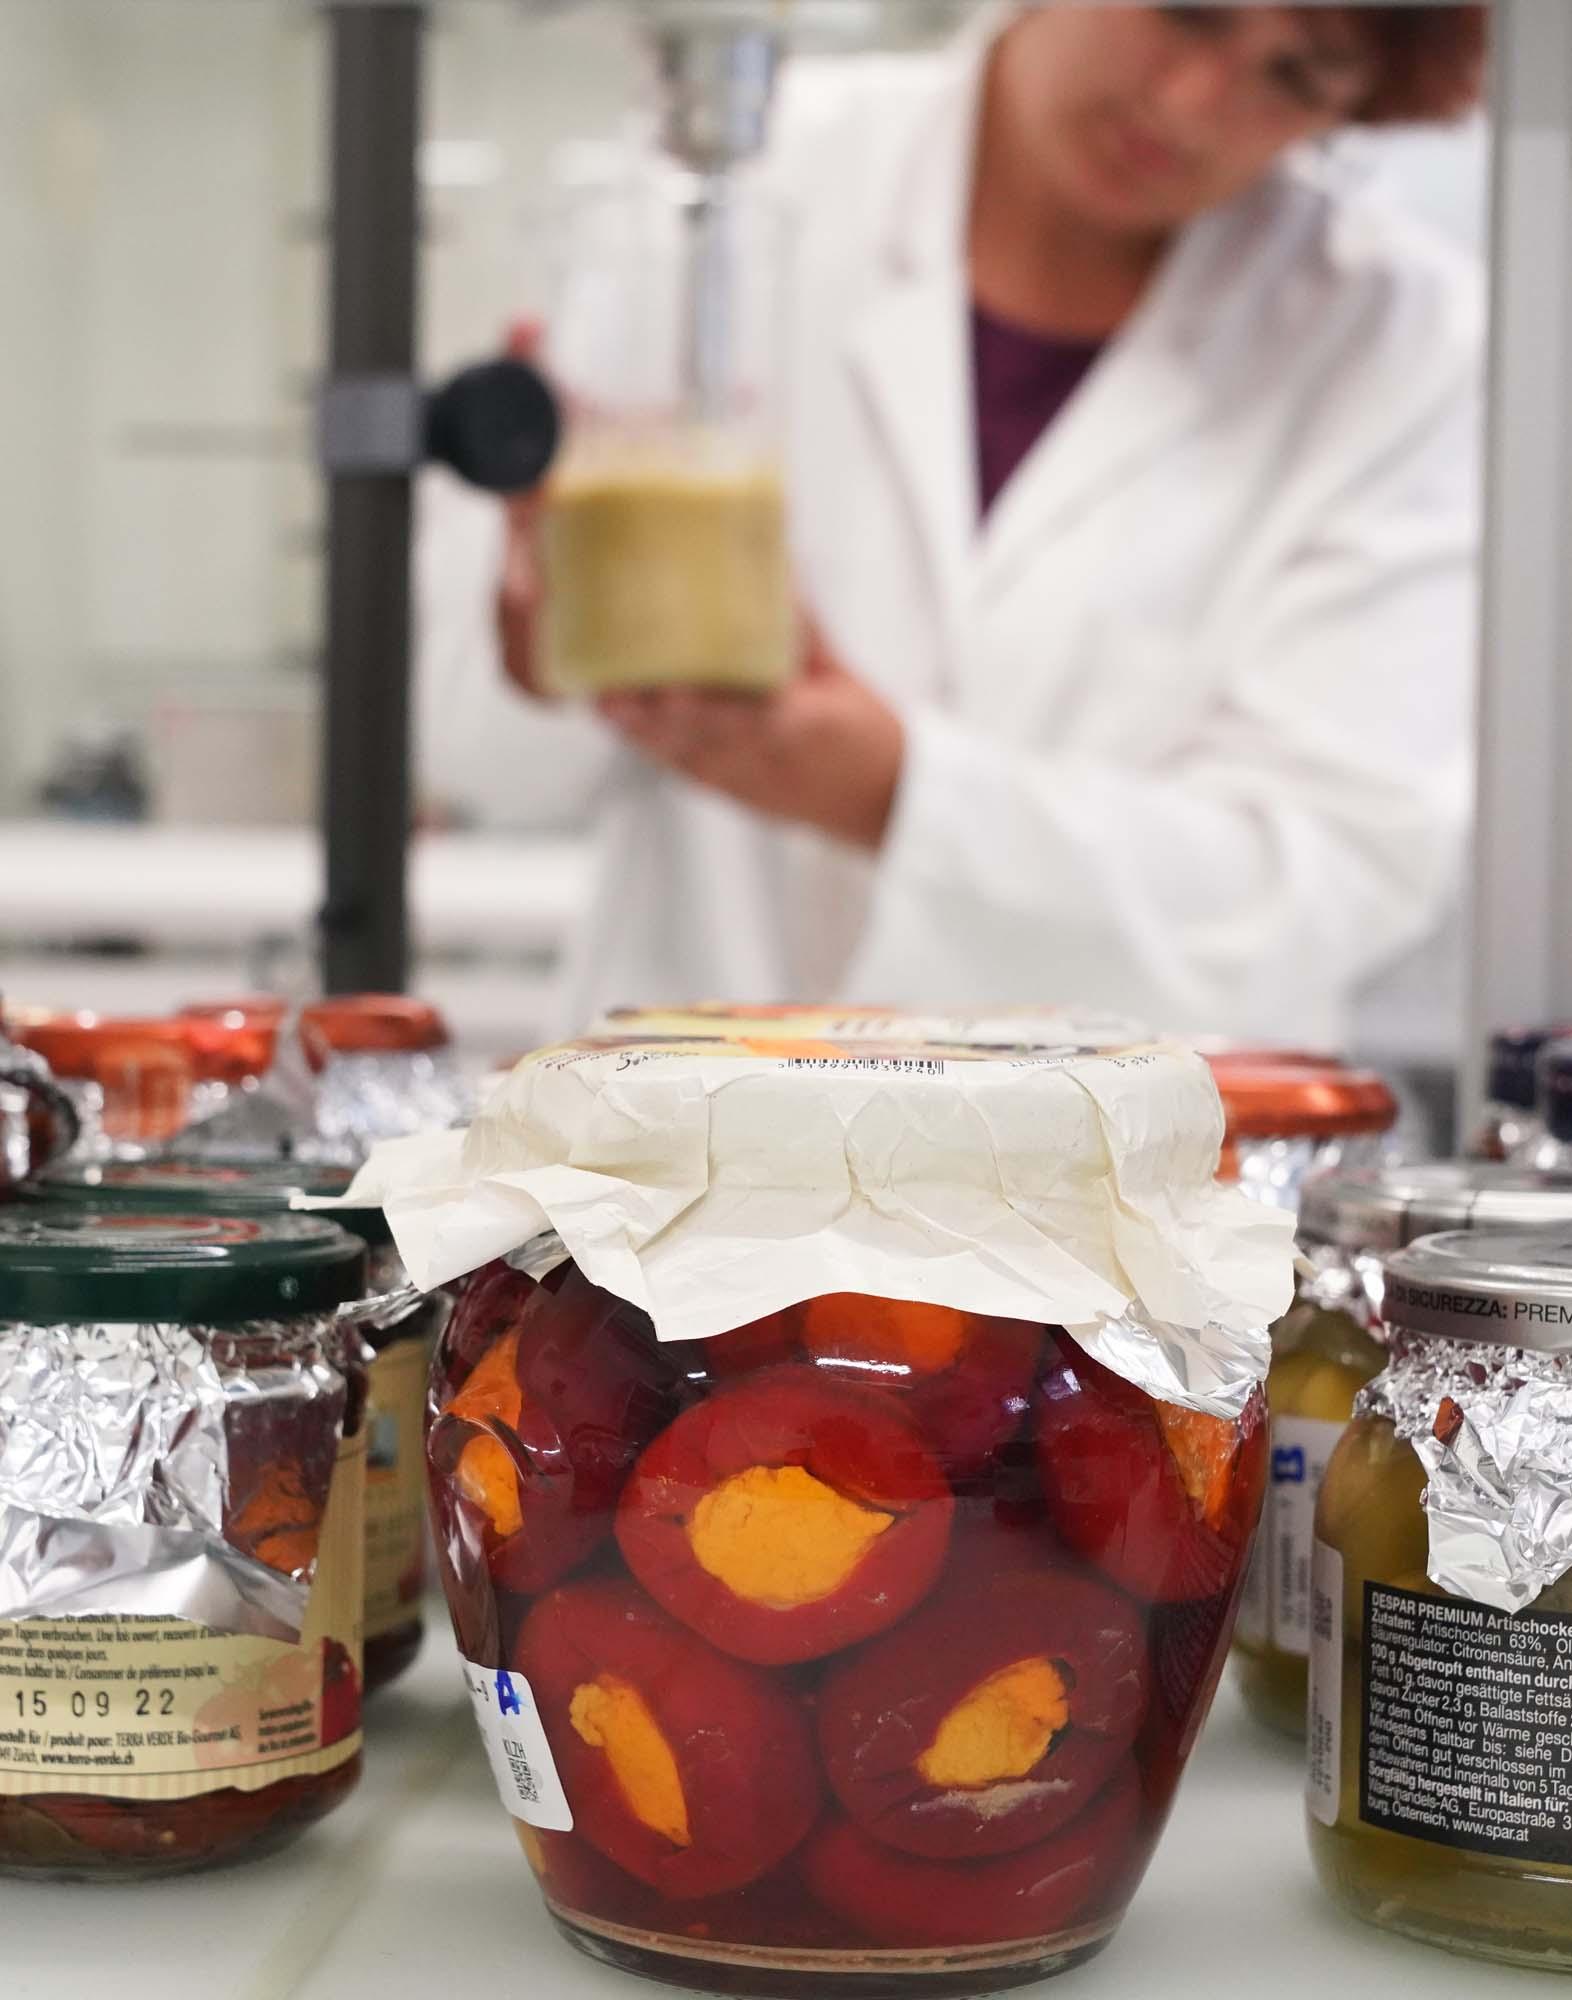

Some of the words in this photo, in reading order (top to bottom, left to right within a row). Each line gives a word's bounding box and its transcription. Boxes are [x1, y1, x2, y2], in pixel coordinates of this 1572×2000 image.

[1408, 1287, 1508, 1319] SICUREZZA:
[1514, 1301, 1572, 1324] PREM
[1370, 1608, 1416, 1632] Zutaten:
[1420, 1622, 1501, 1646] Artischocken
[1509, 1633, 1547, 1654] 63%,
[1371, 1591, 1416, 1616] DESPAR
[1418, 1602, 1484, 1628] PREMIUM
[1370, 1623, 1451, 1655] Säureregulator:
[1453, 1641, 1549, 1671] Citronensäure,
[1370, 1643, 1387, 1659] 100
[1388, 1648, 1396, 1661] g
[1399, 1650, 1463, 1677] Abgetropft
[1465, 1665, 1532, 1686] enthalten
[16, 1690, 47, 1717] 15
[71, 1691, 111, 1718] 09
[135, 1688, 175, 1716] 22
[494, 1668, 521, 1716] A
[1369, 1679, 1399, 1700] davon
[1401, 1686, 1441, 1708] Zucker
[1441, 1698, 1461, 1714] 2,3
[1479, 1702, 1568, 1727] Ballaststoffe
[1371, 1661, 1390, 1680] Fett
[1392, 1667, 1404, 1683] 10
[1417, 1674, 1453, 1694] davon
[1455, 1681, 1522, 1706] gesättigte
[1369, 1696, 1386, 1713] Vor
[1387, 1702, 1411, 1720] dem
[1413, 1704, 1453, 1730] Öffnen
[1457, 1721, 1478, 1734] vor
[1482, 1720, 1531, 1742] Wärme
[1369, 1713, 1427, 1741] Mindestens
[1432, 1728, 1476, 1750] haltbar
[1482, 1737, 1507, 1756] bis:
[1514, 1743, 1552, 1760] siehe
[1368, 1730, 1390, 1747] dem
[1432, 1746, 1451, 1763] gut
[1455, 1751, 1543, 1777] verschlossen
[1548, 1762, 1567, 1779] im
[1368, 1747, 1429, 1774] aufbewahren
[1430, 1761, 1451, 1779] und
[1454, 1767, 1510, 1789] innerhalb
[1512, 1779, 1536, 1793] von
[1538, 1779, 1548, 1794] 5
[1368, 1759, 1416, 1789] Sorgfältig
[1417, 1774, 1483, 1801] hergestellt
[1484, 1788, 1497, 1804] in
[1499, 1790, 1542, 1810] Italien
[1544, 1796, 1570, 1813] für:
[1368, 1775, 1463, 1816] Warenhandels-AG,
[1468, 1801, 1557, 1829] Europastraße
[1452, 1818, 1530, 1842] www.spar.at
